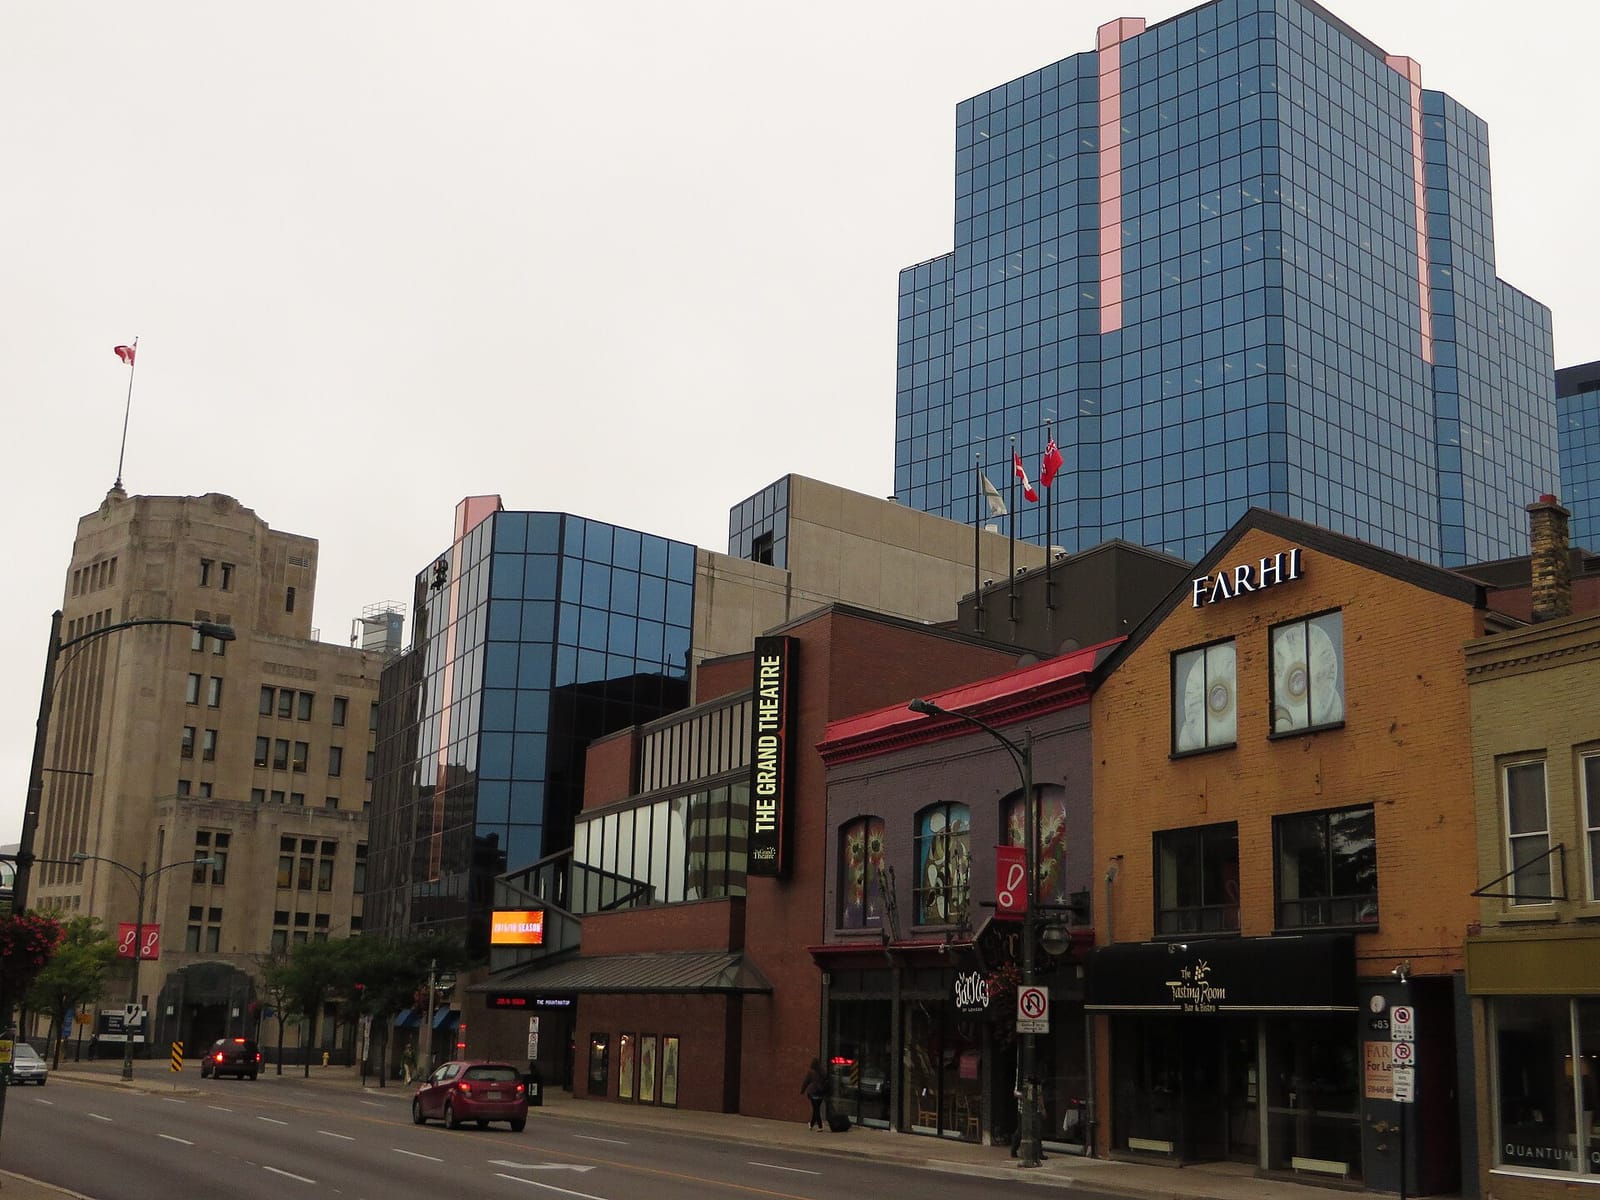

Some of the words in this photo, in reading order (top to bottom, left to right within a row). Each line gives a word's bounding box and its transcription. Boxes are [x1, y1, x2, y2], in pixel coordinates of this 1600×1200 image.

[1192, 548, 1302, 608] FARHI
[759, 655, 780, 733] THEATRE
[756, 735, 778, 795] GRAND
[755, 799, 776, 834] THE
[519, 923, 541, 933] SEASON
[1180, 966, 1191, 980] The
[1166, 982, 1200, 1003] Tasting
[1198, 981, 1225, 1003] Room
[1367, 1045, 1390, 1058] FAR
[1367, 1060, 1381, 1071] For
[1505, 1143, 1574, 1161] QUANTUM
